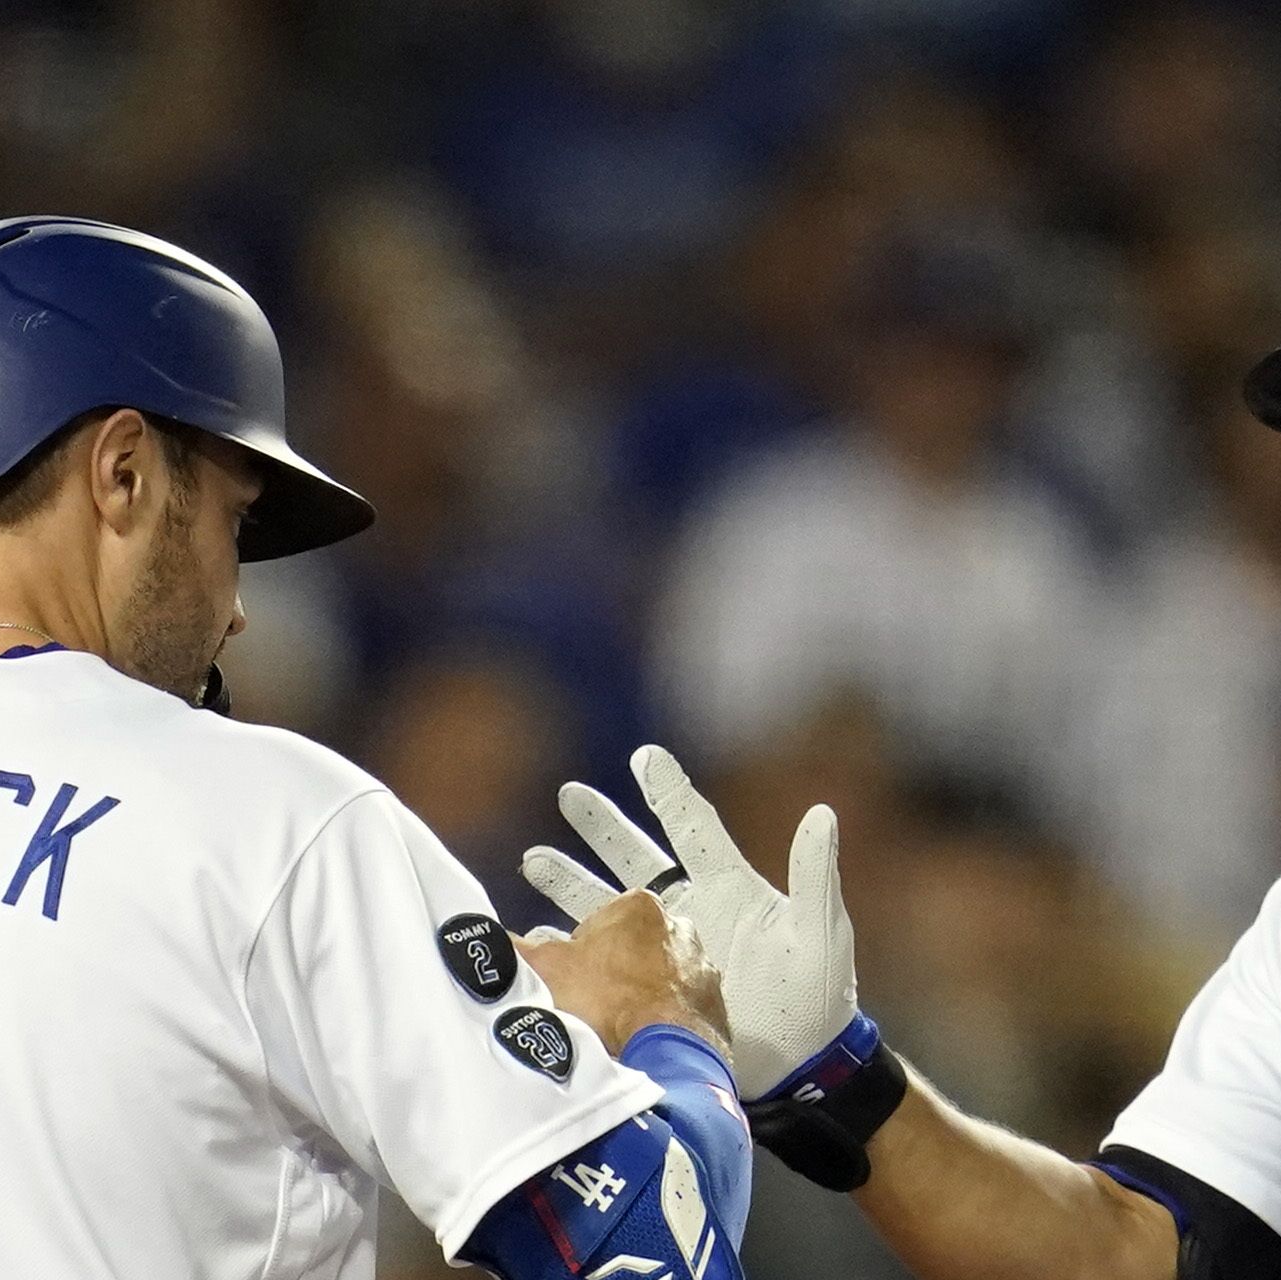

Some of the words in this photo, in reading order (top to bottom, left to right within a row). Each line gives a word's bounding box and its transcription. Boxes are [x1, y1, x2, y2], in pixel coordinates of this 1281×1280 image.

[443, 921, 491, 945] TOMMY
[467, 940, 500, 986] 2
[501, 1010, 544, 1038] SUTTON
[516, 1021, 568, 1068] 20
[550, 1162, 628, 1213] LA
